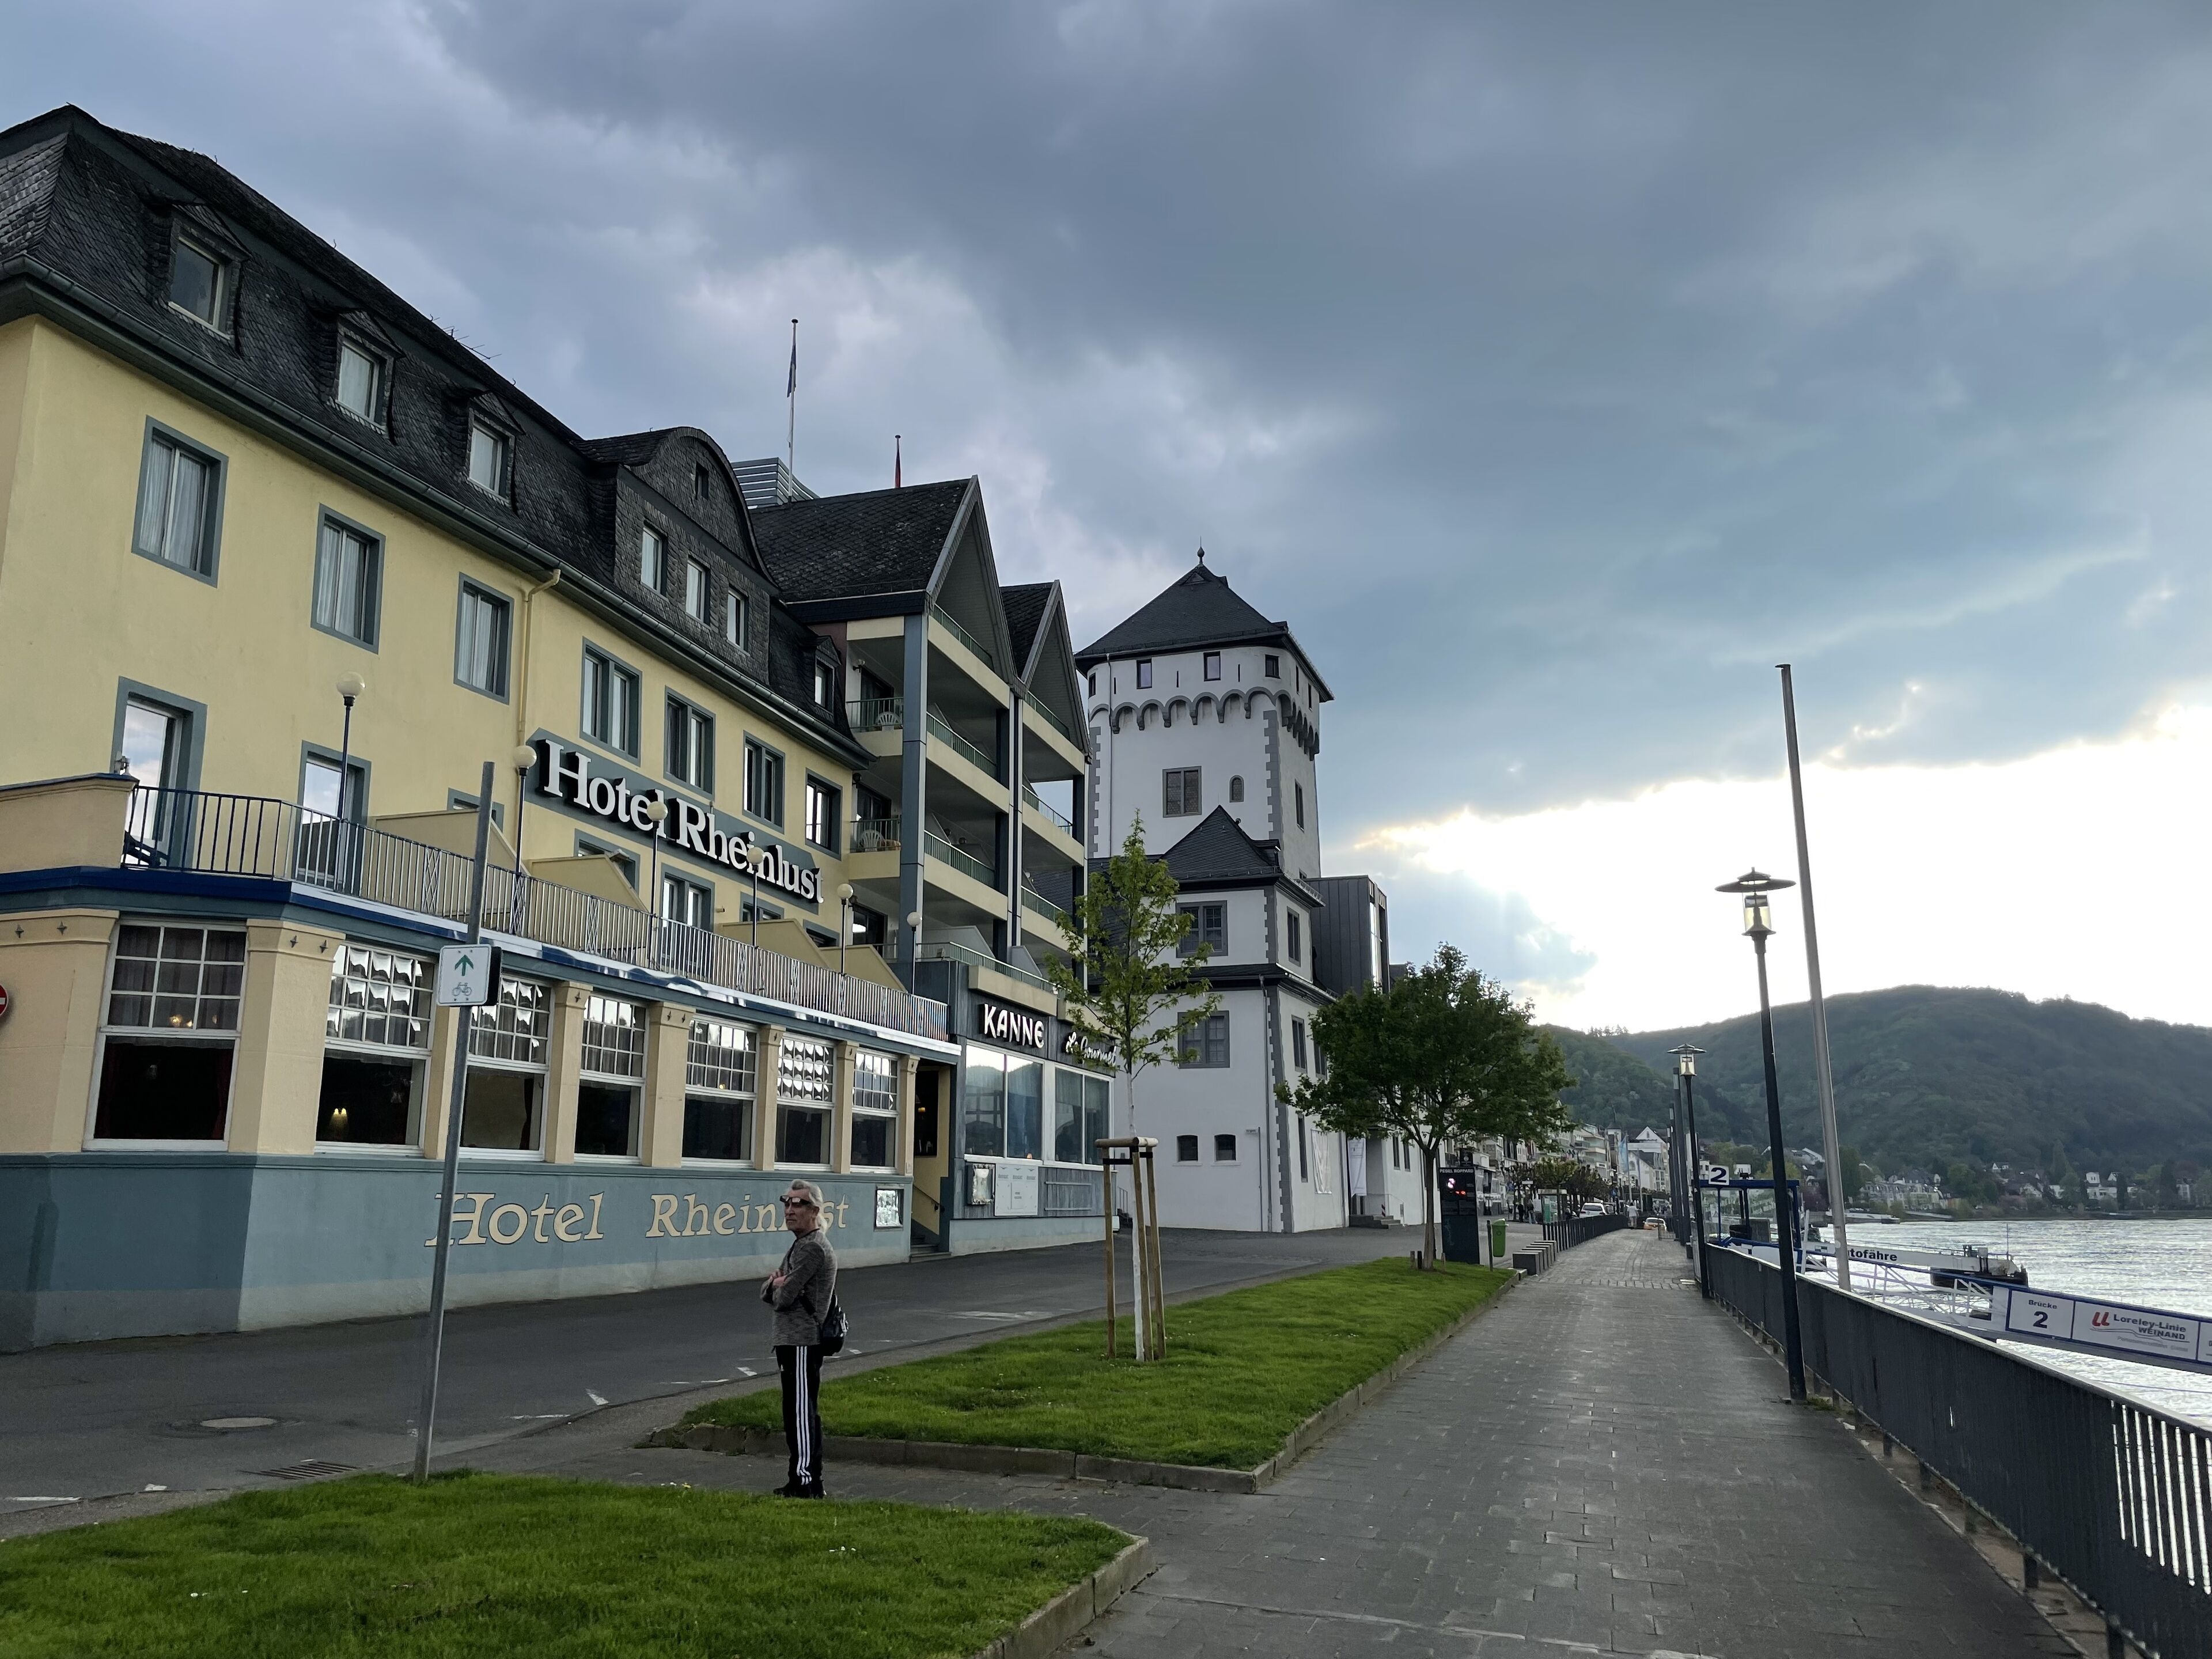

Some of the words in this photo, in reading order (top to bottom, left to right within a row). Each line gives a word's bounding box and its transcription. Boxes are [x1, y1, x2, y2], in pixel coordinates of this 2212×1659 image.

[543, 738, 667, 839] Hotel
[676, 797, 824, 904] Rheinlust
[983, 1003, 1045, 1048] KANNE
[1710, 1167, 1728, 1184] 2
[424, 1191, 605, 1247] Hotel
[645, 1193, 850, 1238] Rheinst
[1848, 1248, 1897, 1262] tofähre
[2028, 1299, 2058, 1309] Brücke
[2033, 1311, 2048, 1329] 2
[2113, 1314, 2187, 1333] Loreley-Linie
[2138, 1327, 2186, 1340] WEINAND
